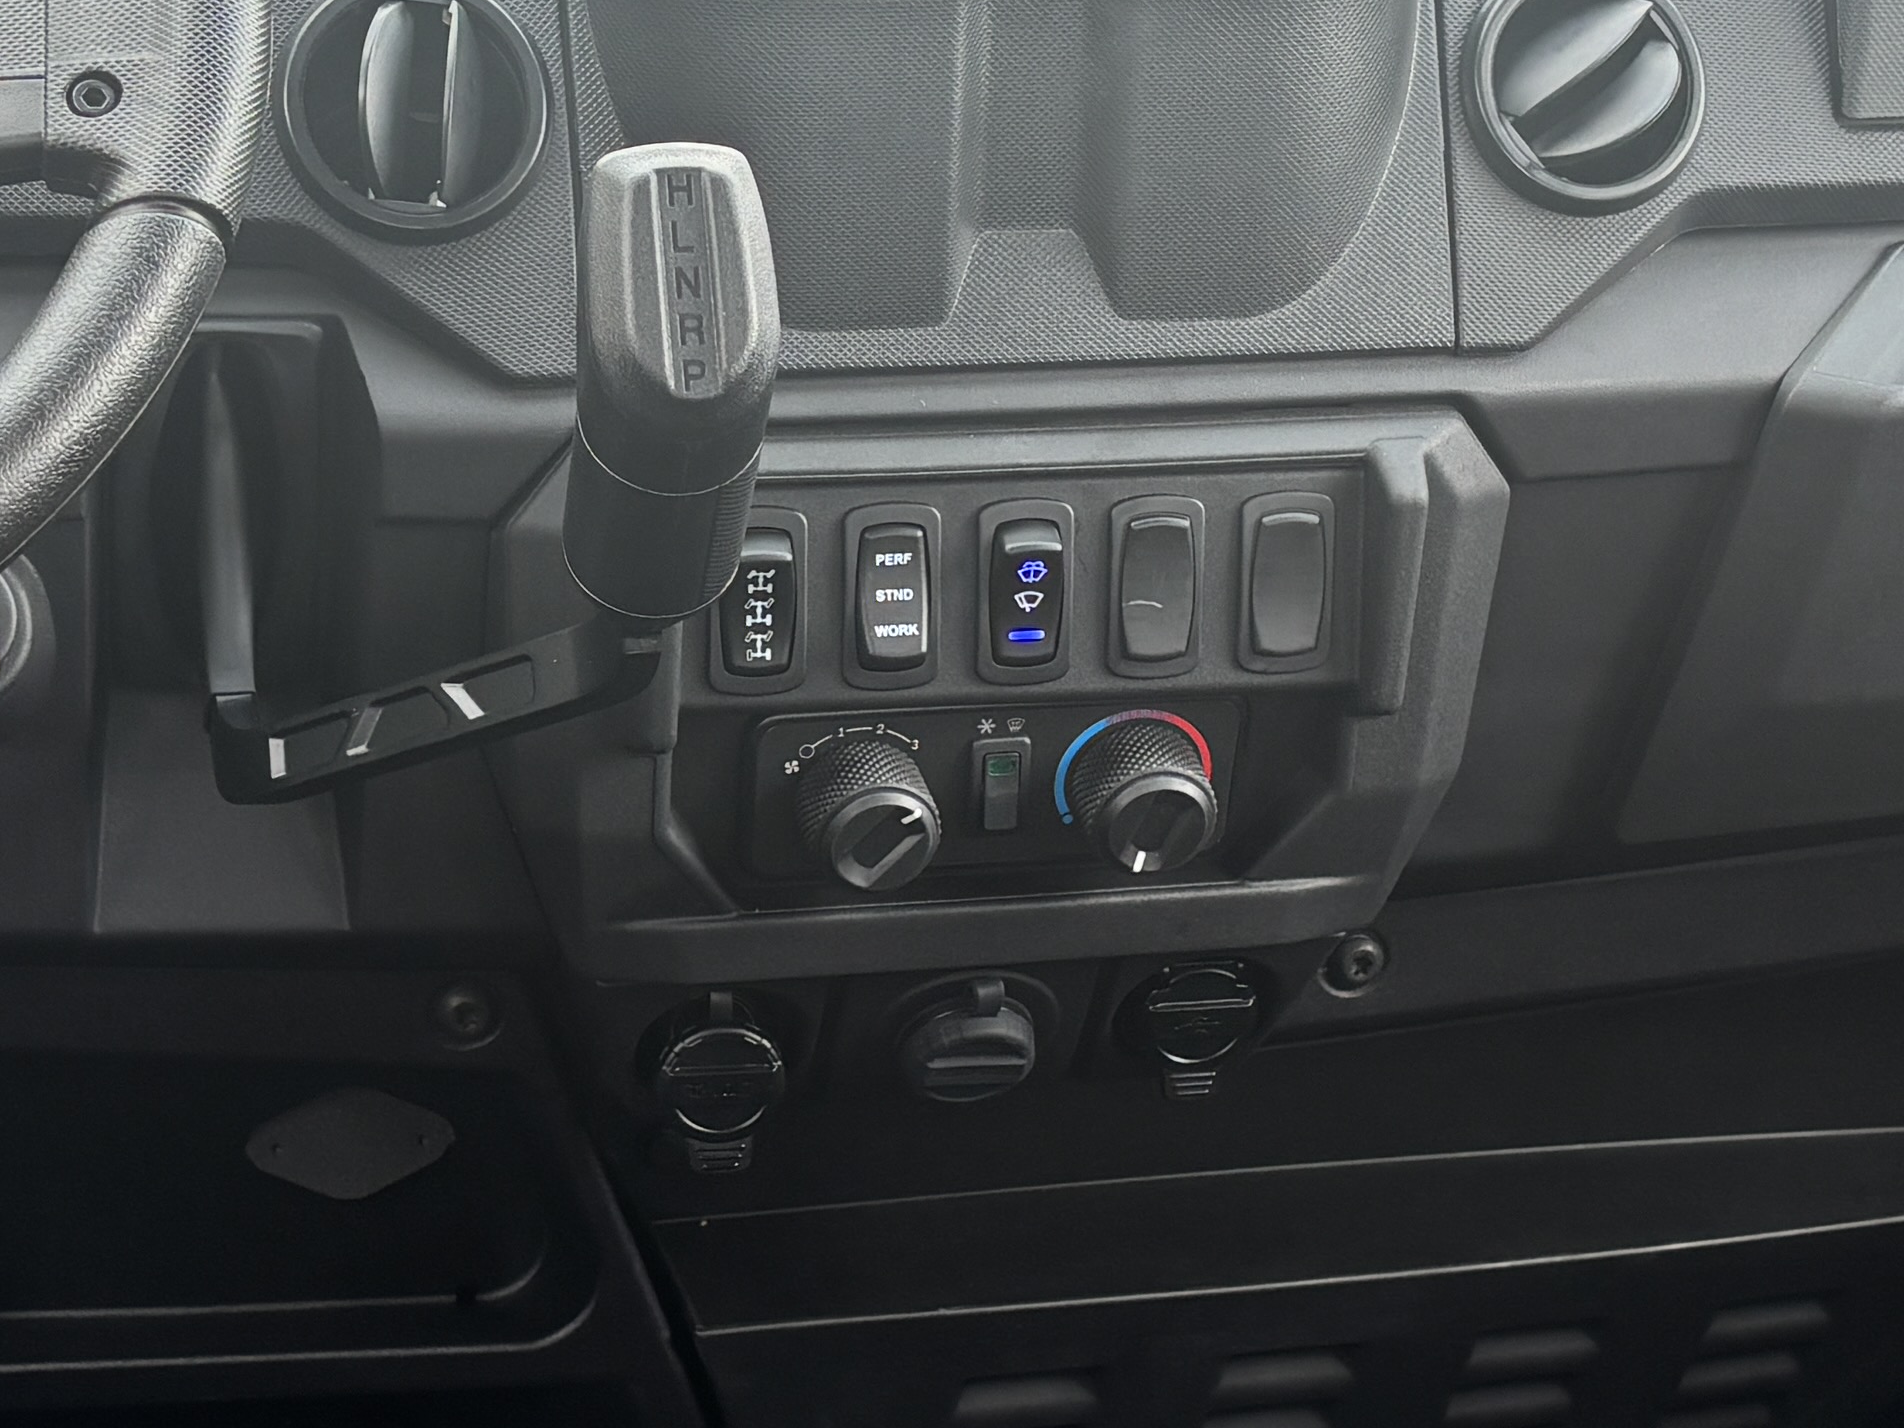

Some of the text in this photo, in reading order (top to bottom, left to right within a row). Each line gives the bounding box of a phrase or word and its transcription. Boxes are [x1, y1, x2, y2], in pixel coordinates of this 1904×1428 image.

[666, 173, 695, 208] H
[670, 220, 695, 254] L
[675, 266, 702, 300] N
[678, 313, 706, 347] R
[681, 358, 707, 393] P
[875, 552, 913, 567] PERF
[875, 589, 915, 603] STND
[874, 623, 920, 638] WORK
[875, 723, 886, 735] 2
[910, 739, 920, 751] 3
